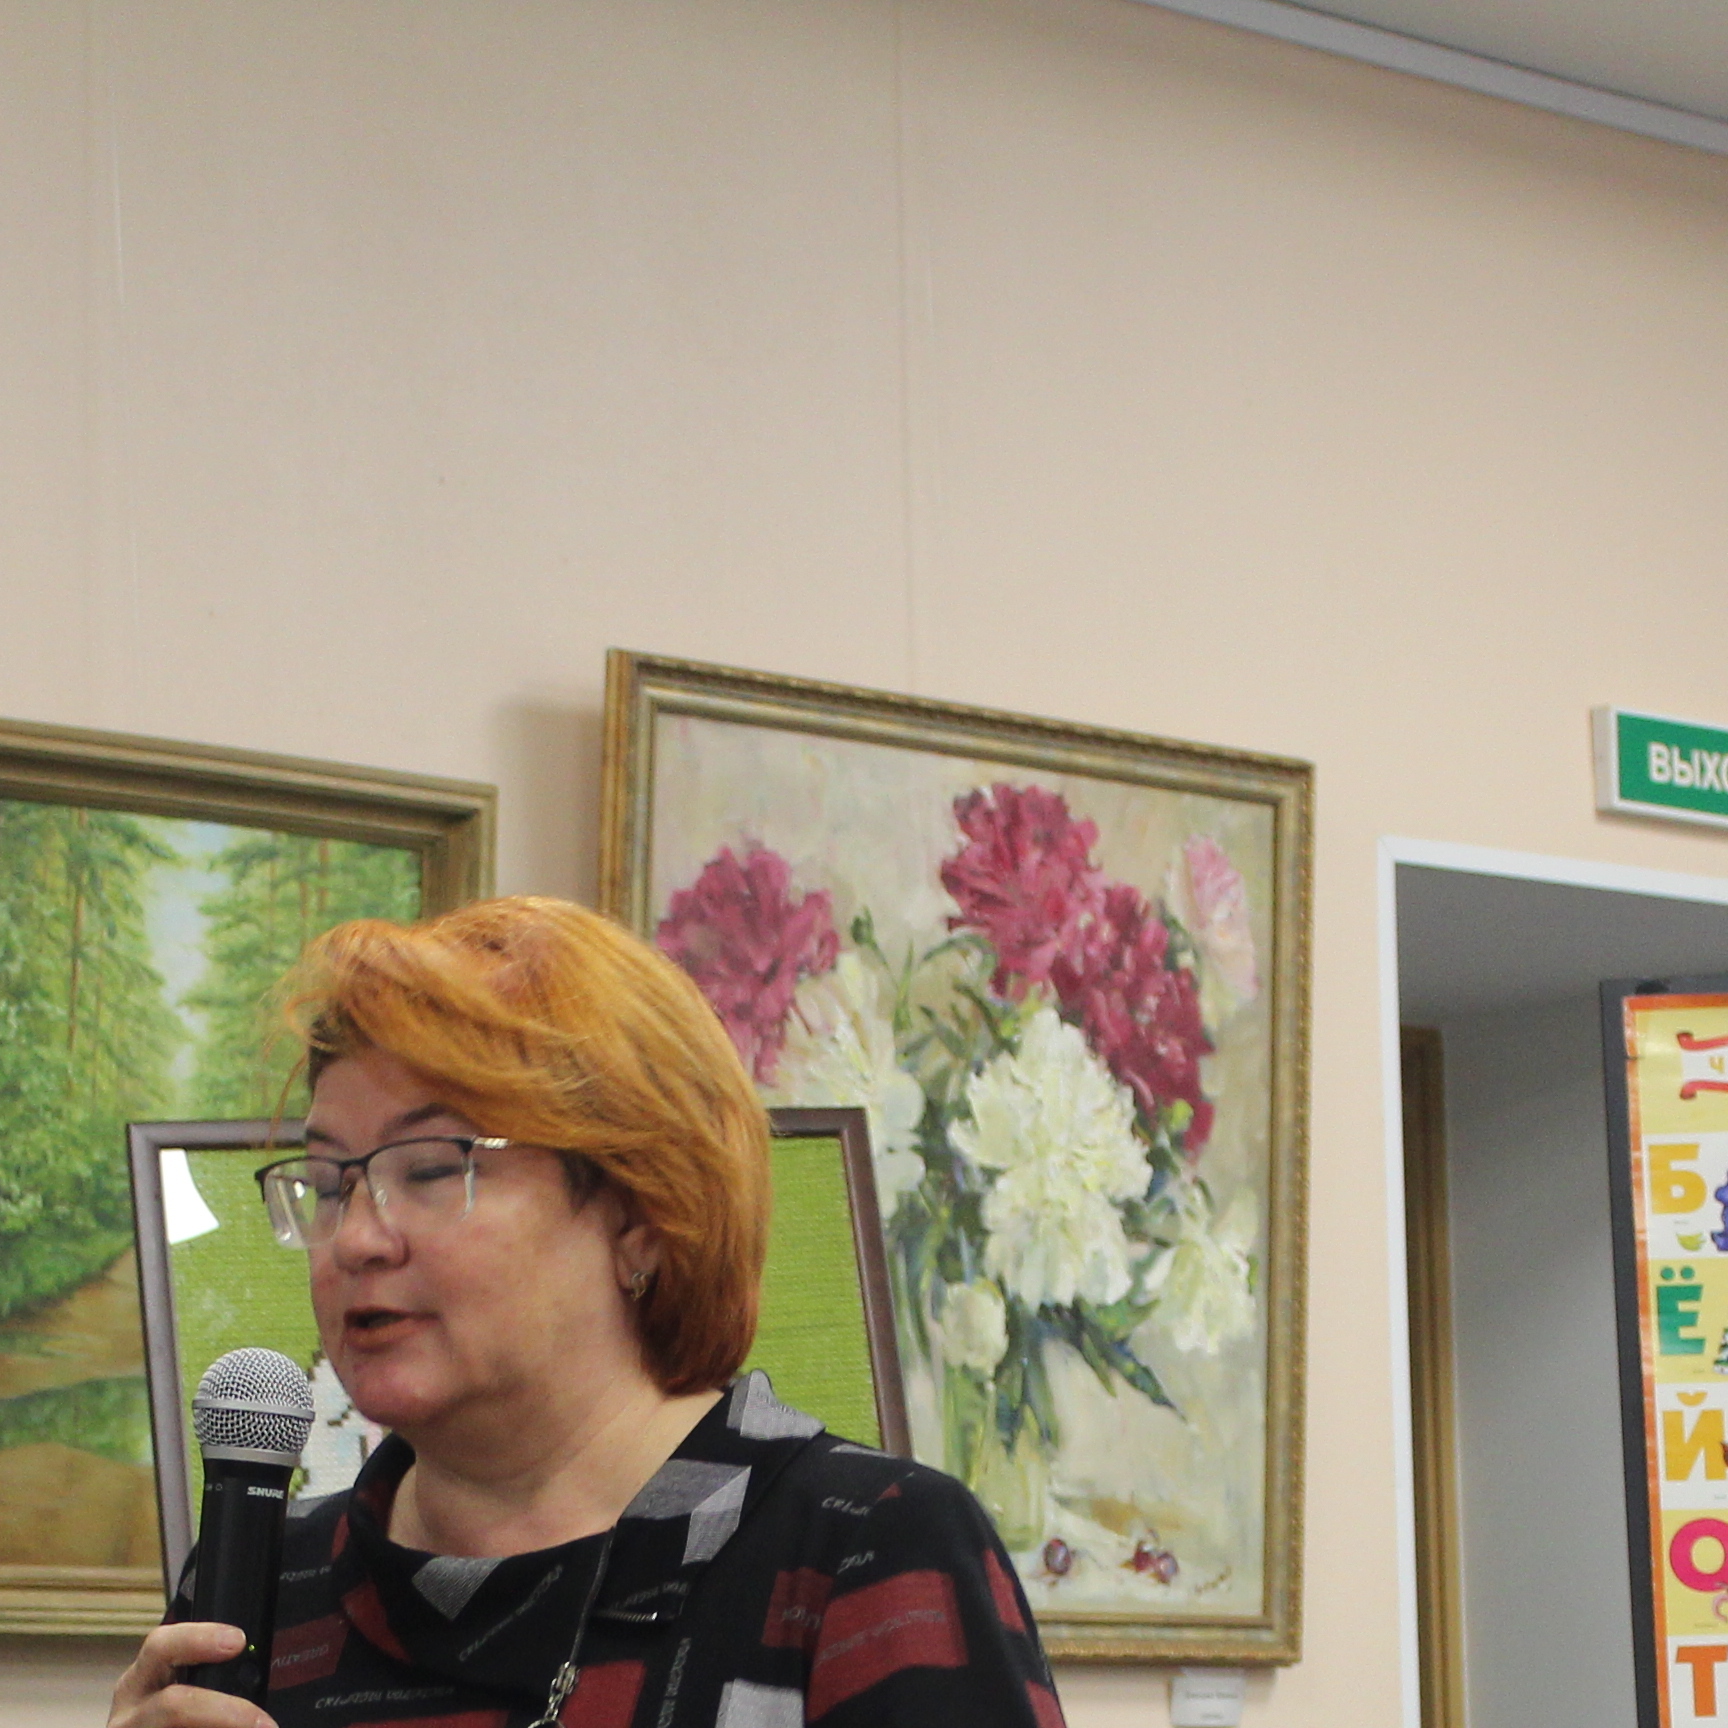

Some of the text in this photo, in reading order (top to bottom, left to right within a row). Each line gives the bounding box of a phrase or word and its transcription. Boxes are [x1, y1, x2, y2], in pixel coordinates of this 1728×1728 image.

[1647, 1143, 1706, 1215] Б
[1657, 1268, 1706, 1356] Ё
[1663, 1392, 1727, 1481] Й
[1676, 1644, 1728, 1717] Т
